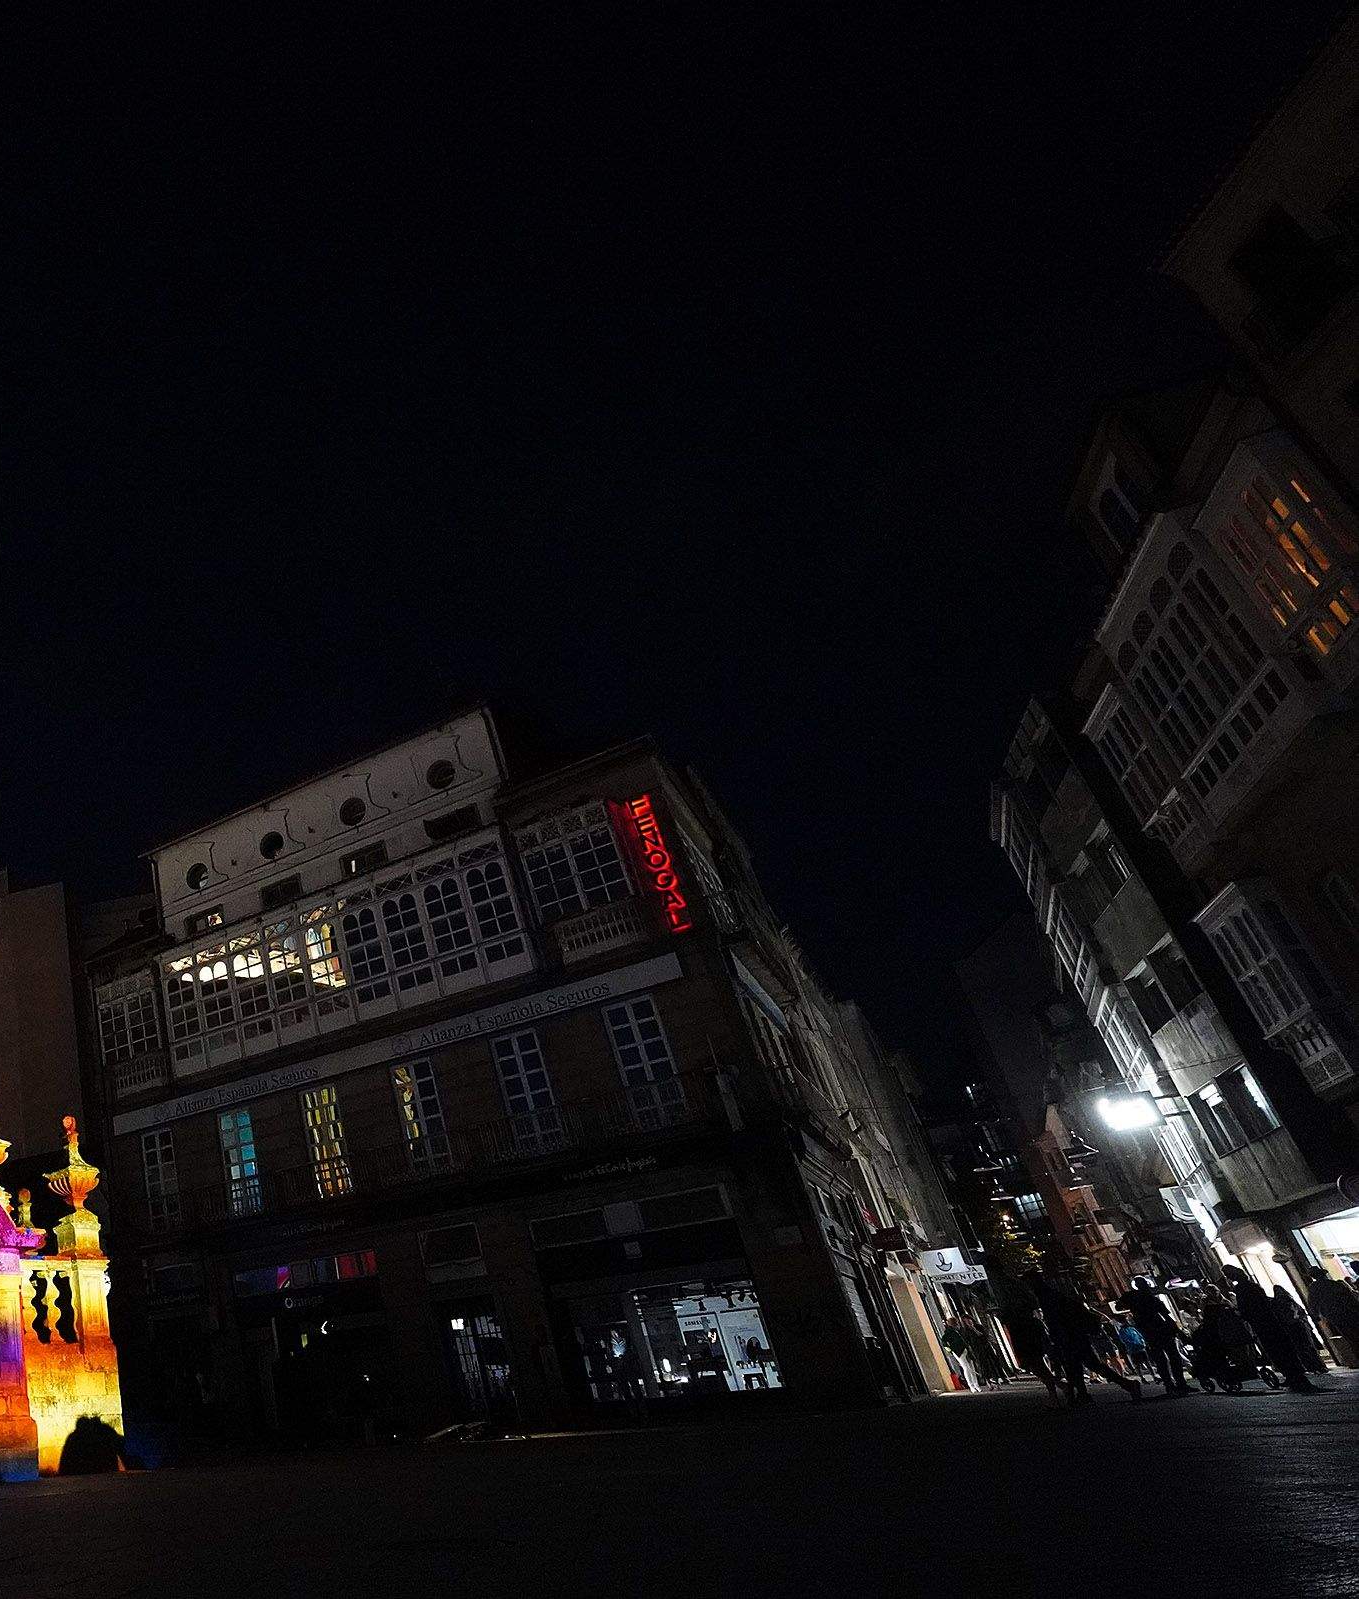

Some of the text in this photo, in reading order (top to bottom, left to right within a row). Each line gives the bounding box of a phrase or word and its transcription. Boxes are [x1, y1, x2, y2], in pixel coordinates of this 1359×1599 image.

[629, 794, 692, 934] FENOGAL
[419, 983, 610, 1047] Alianza Española Seguros
[175, 1067, 319, 1116] Alianza Española Seguros
